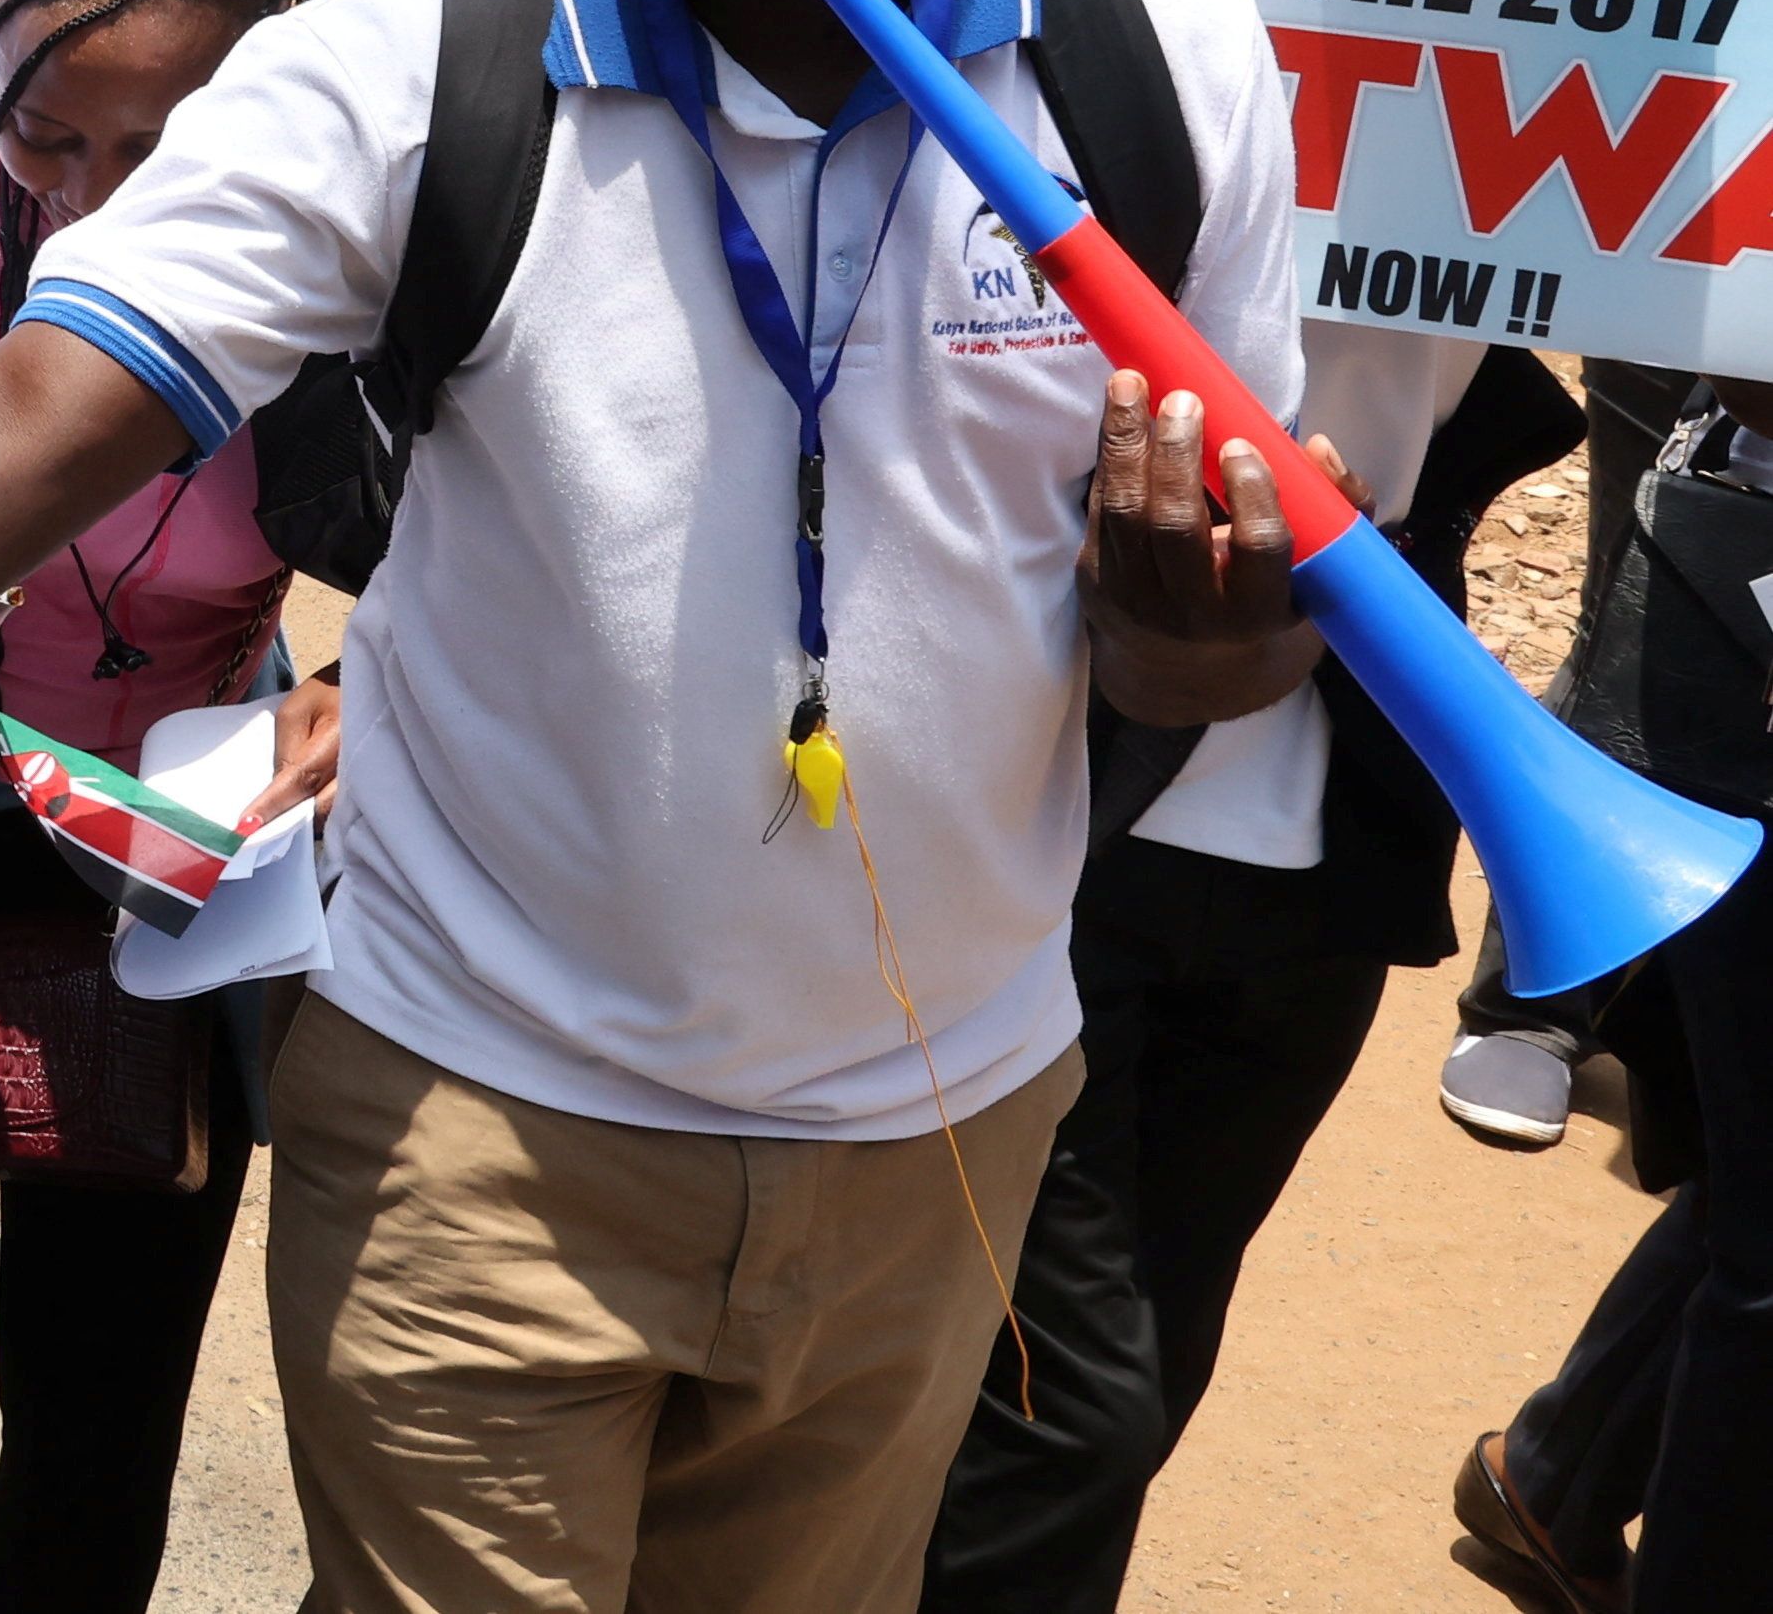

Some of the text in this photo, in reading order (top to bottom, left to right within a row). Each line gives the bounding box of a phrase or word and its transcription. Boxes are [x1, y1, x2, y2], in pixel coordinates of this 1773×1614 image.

[972, 267, 1017, 300] KN
[1316, 242, 1563, 338] NOW !!
[968, 317, 1013, 335] National
[1005, 336, 1055, 352] Protection
